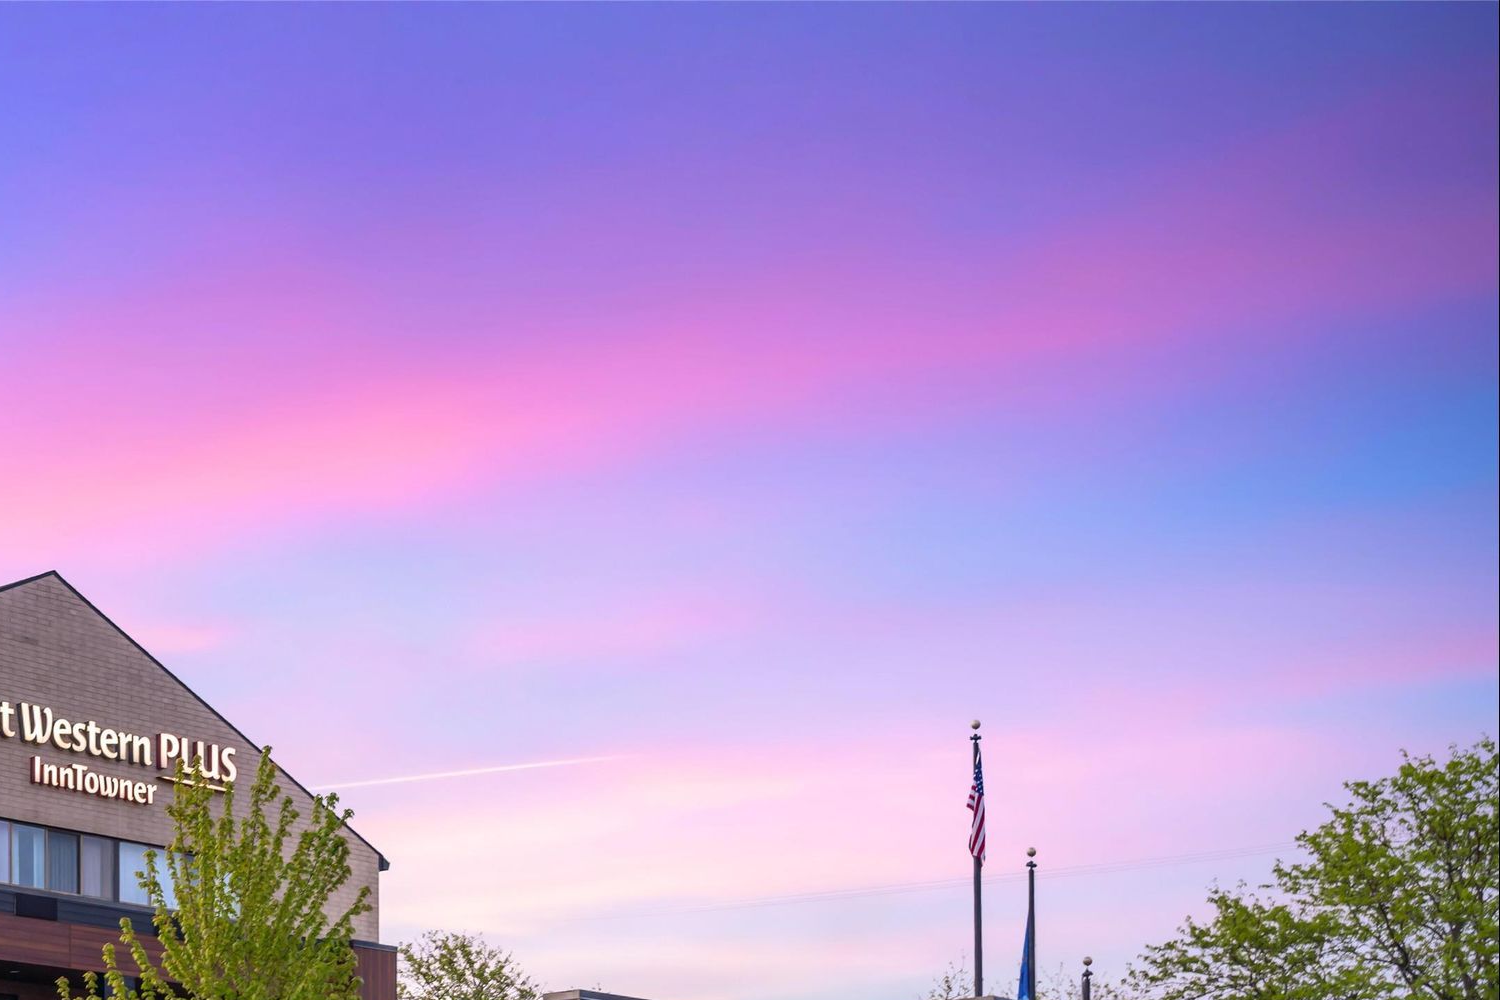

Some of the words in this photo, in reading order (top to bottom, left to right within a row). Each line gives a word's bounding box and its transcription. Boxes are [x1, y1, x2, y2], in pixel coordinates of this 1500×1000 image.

[20, 702, 153, 767] Western
[159, 733, 237, 783] PLUS
[33, 755, 157, 804] InnTowner
